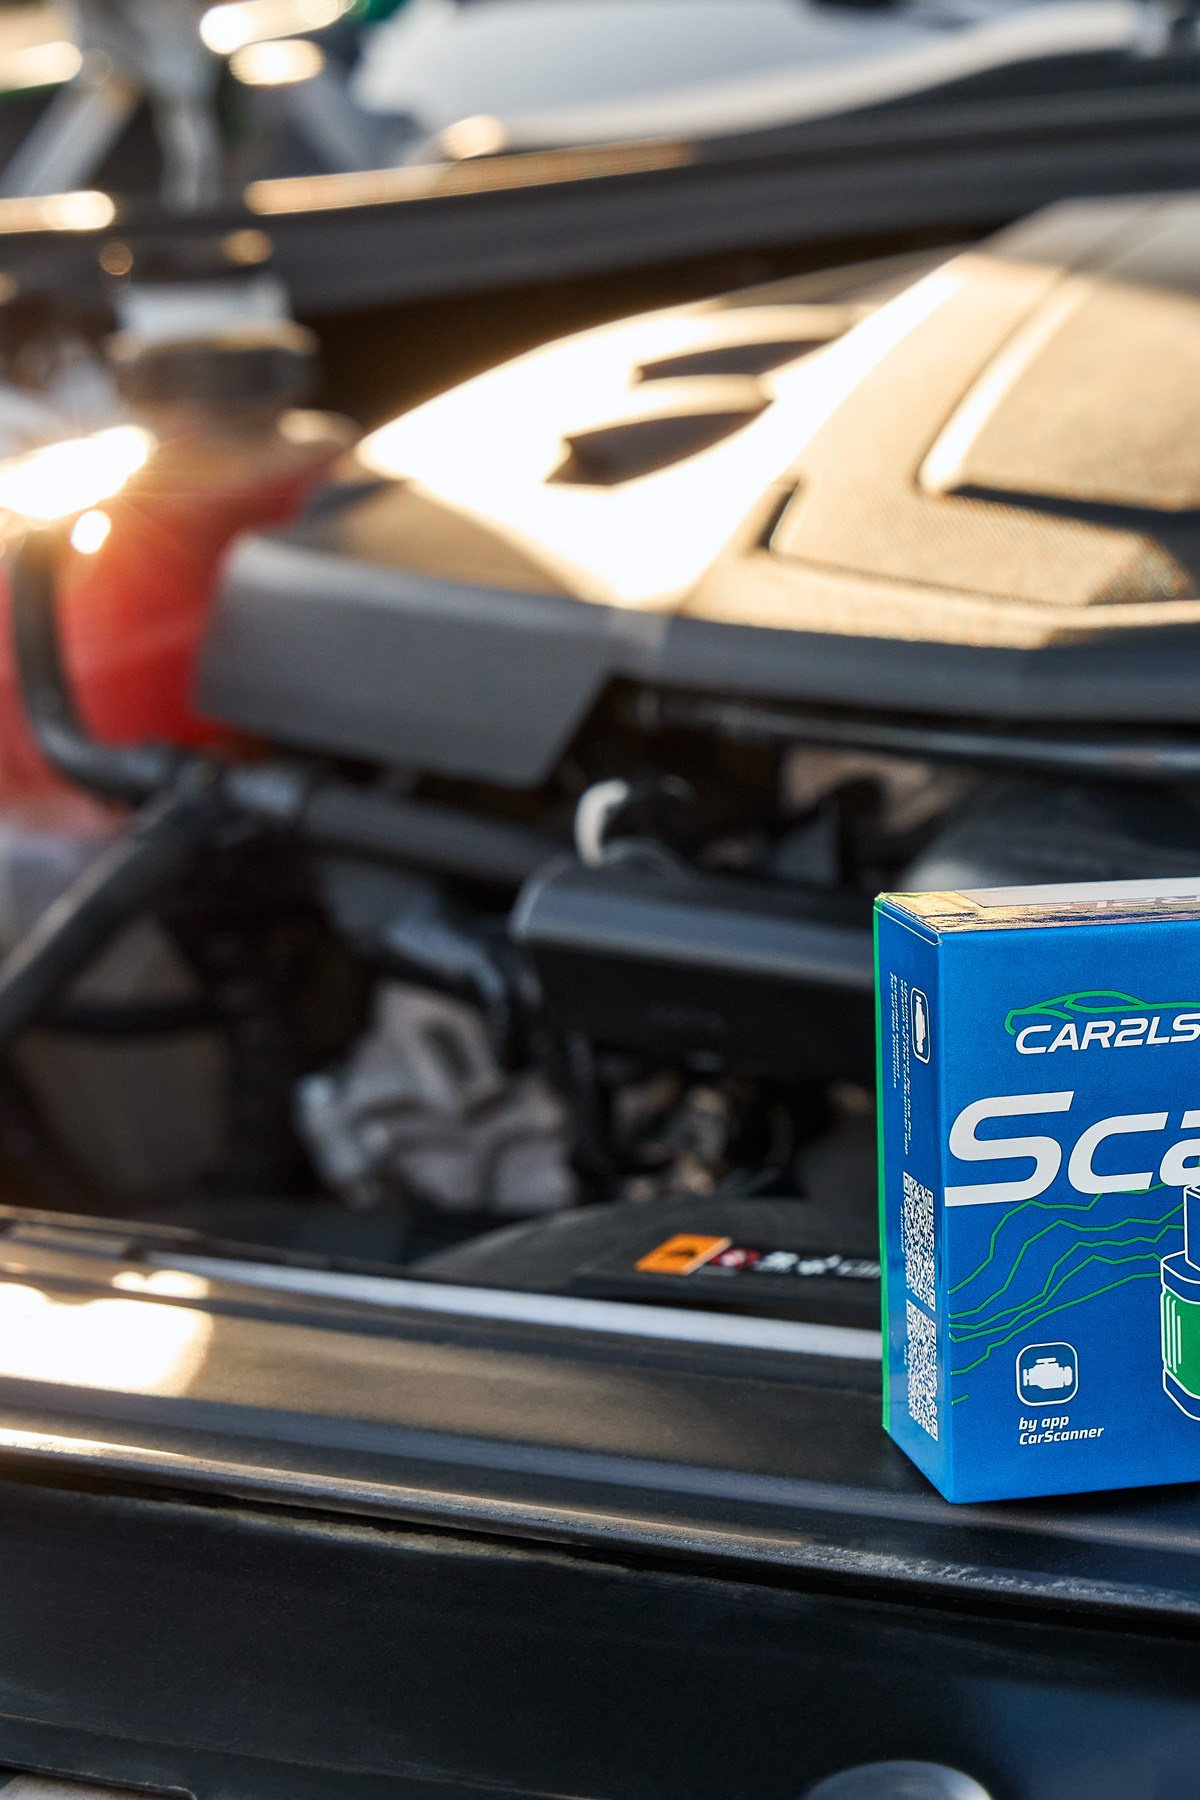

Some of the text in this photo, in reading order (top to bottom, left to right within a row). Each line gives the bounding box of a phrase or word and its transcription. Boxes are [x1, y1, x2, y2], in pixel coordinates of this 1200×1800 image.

[1019, 1416, 1069, 1432] by app
[1019, 1427, 1104, 1445] CarScanner
